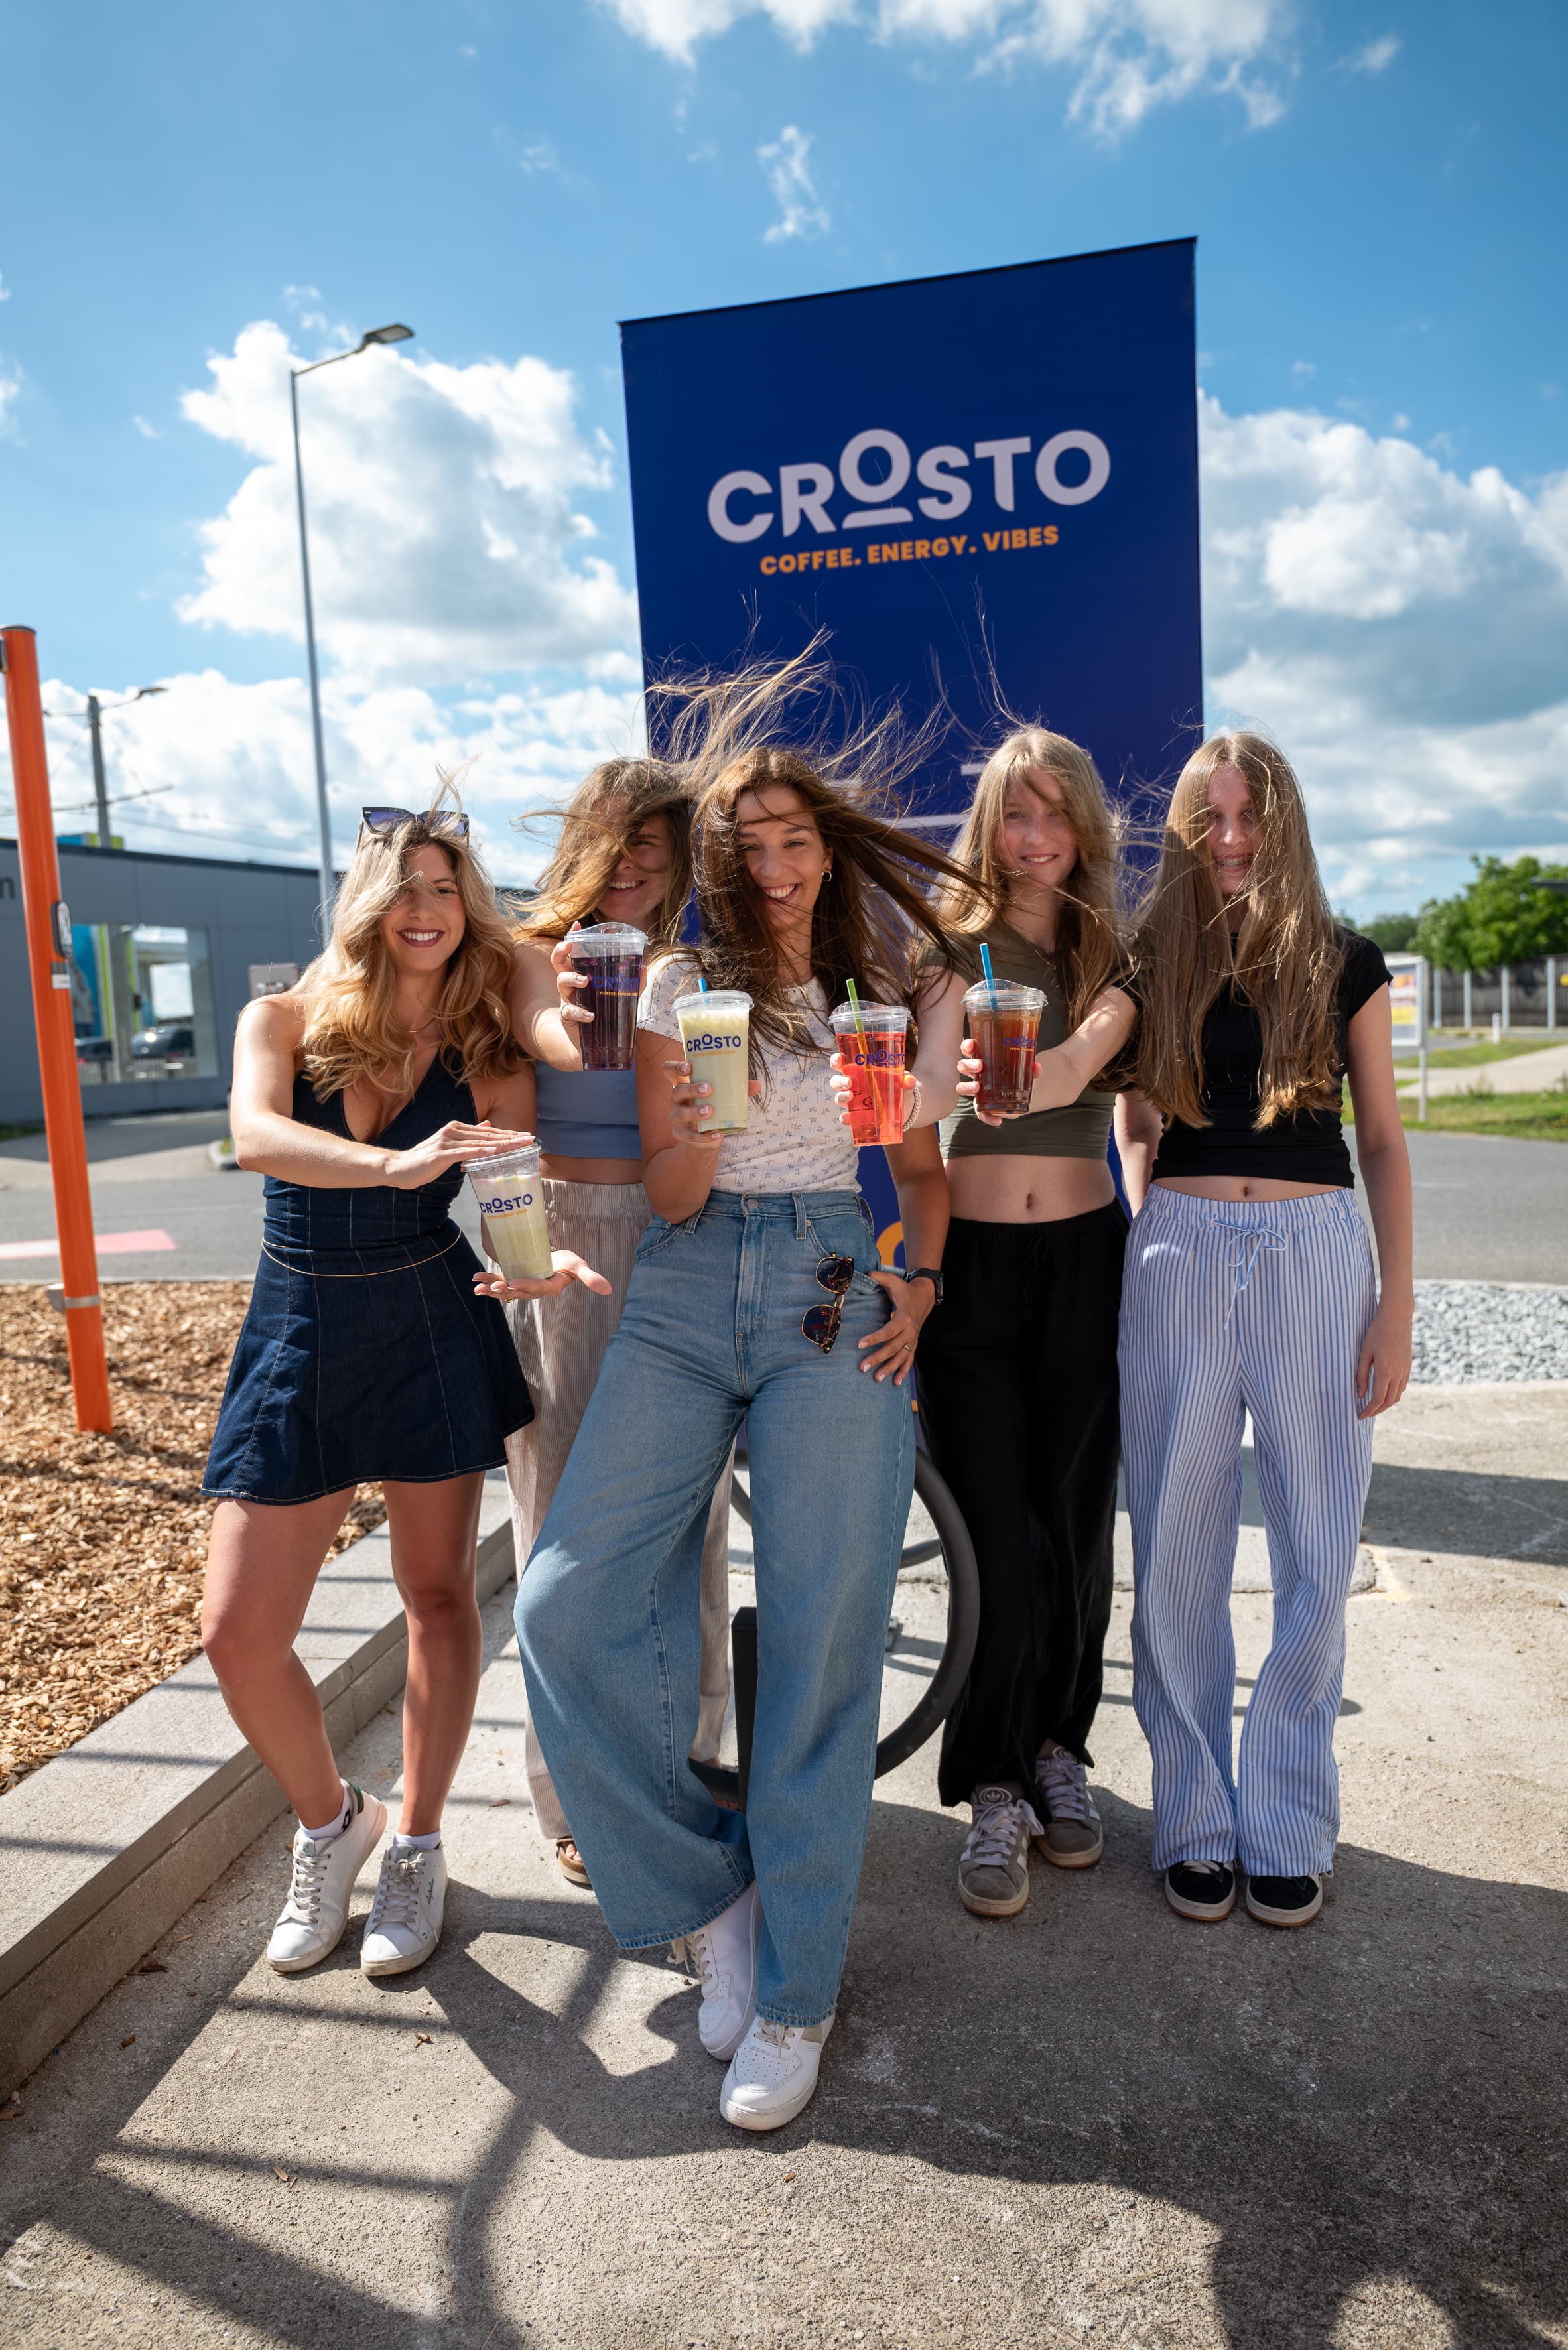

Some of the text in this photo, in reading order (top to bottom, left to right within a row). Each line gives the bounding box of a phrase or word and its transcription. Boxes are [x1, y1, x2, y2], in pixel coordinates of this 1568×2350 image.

[707, 428, 1111, 543] CROSTO
[760, 525, 1059, 576] COFFEE. ENERGY. VIBES
[591, 973, 641, 991] CROST
[686, 1033, 741, 1052] CROSTO
[480, 1193, 533, 1214] CROSTO
